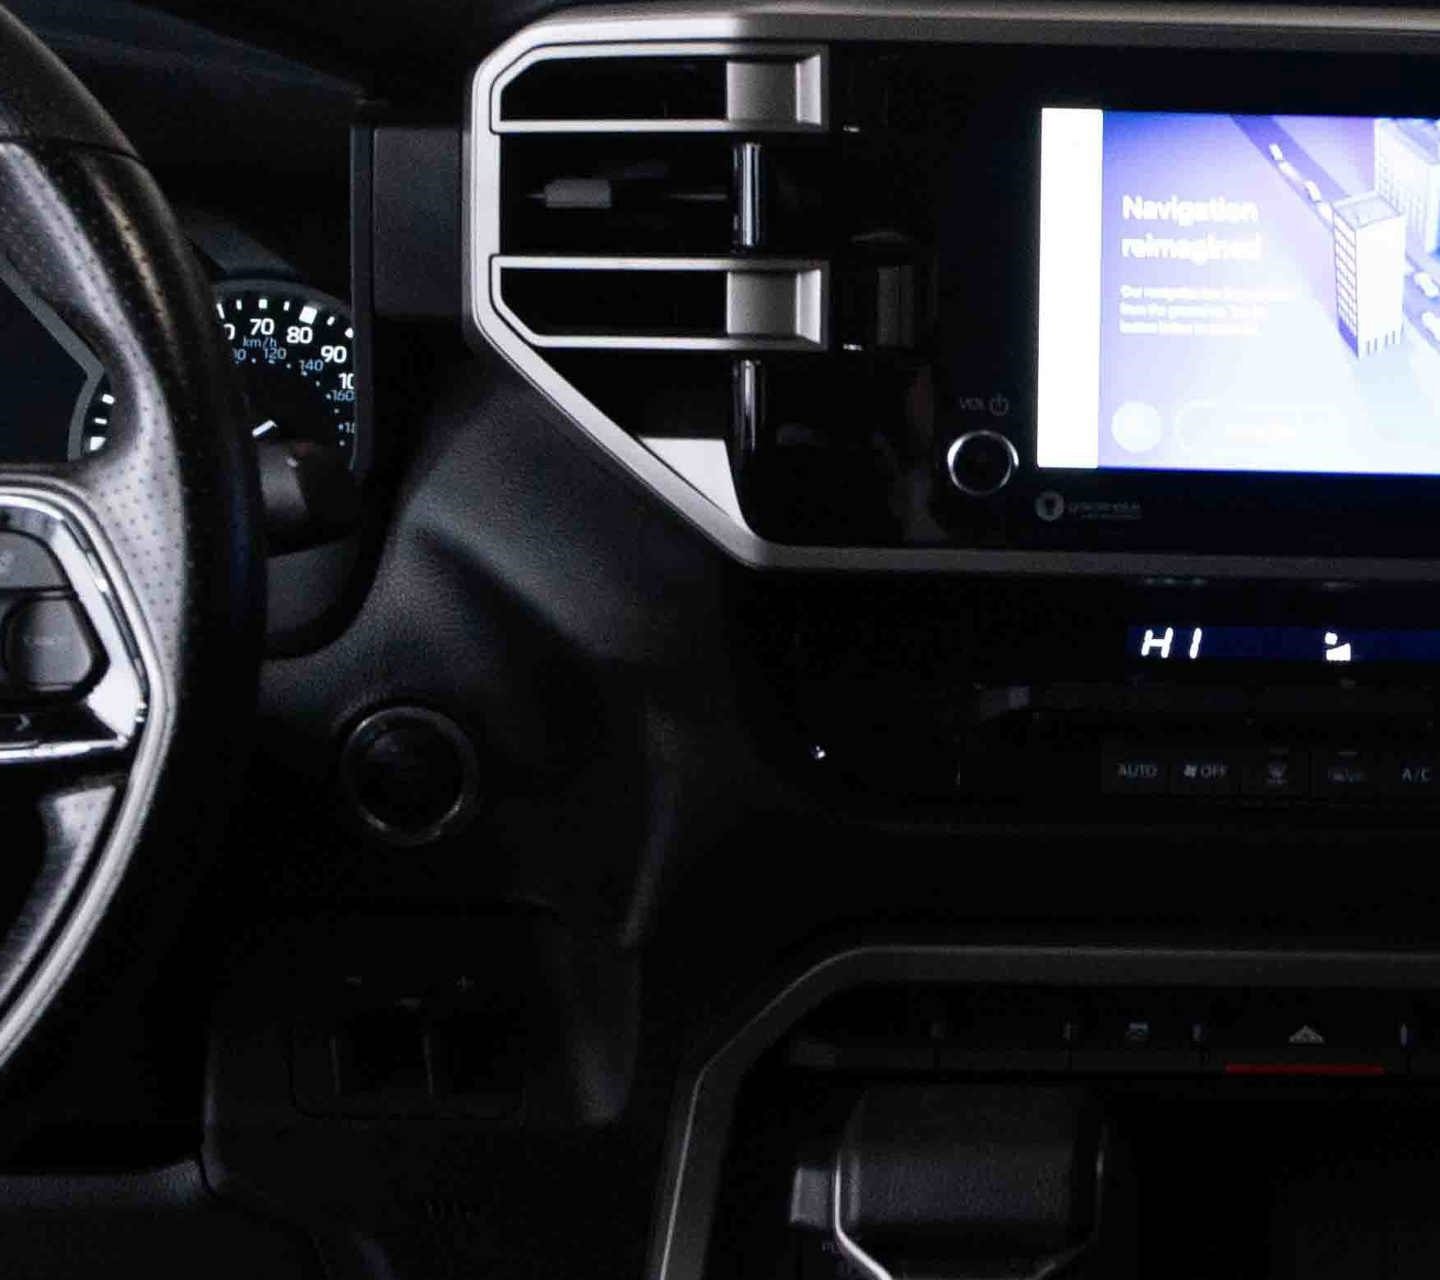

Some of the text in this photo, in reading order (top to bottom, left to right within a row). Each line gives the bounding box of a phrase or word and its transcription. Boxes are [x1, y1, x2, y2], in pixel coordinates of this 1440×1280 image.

[1121, 194, 1261, 228] Navigation
[242, 336, 278, 349] km/h
[248, 317, 276, 336] 70
[285, 325, 314, 345] 80
[320, 344, 348, 364] 90
[263, 347, 288, 362] 120
[297, 358, 325, 373] 140
[1140, 626, 1203, 661] HI
[1116, 762, 1160, 778] AUTO
[1200, 763, 1229, 778] OFF
[1401, 766, 1433, 783] A/C
